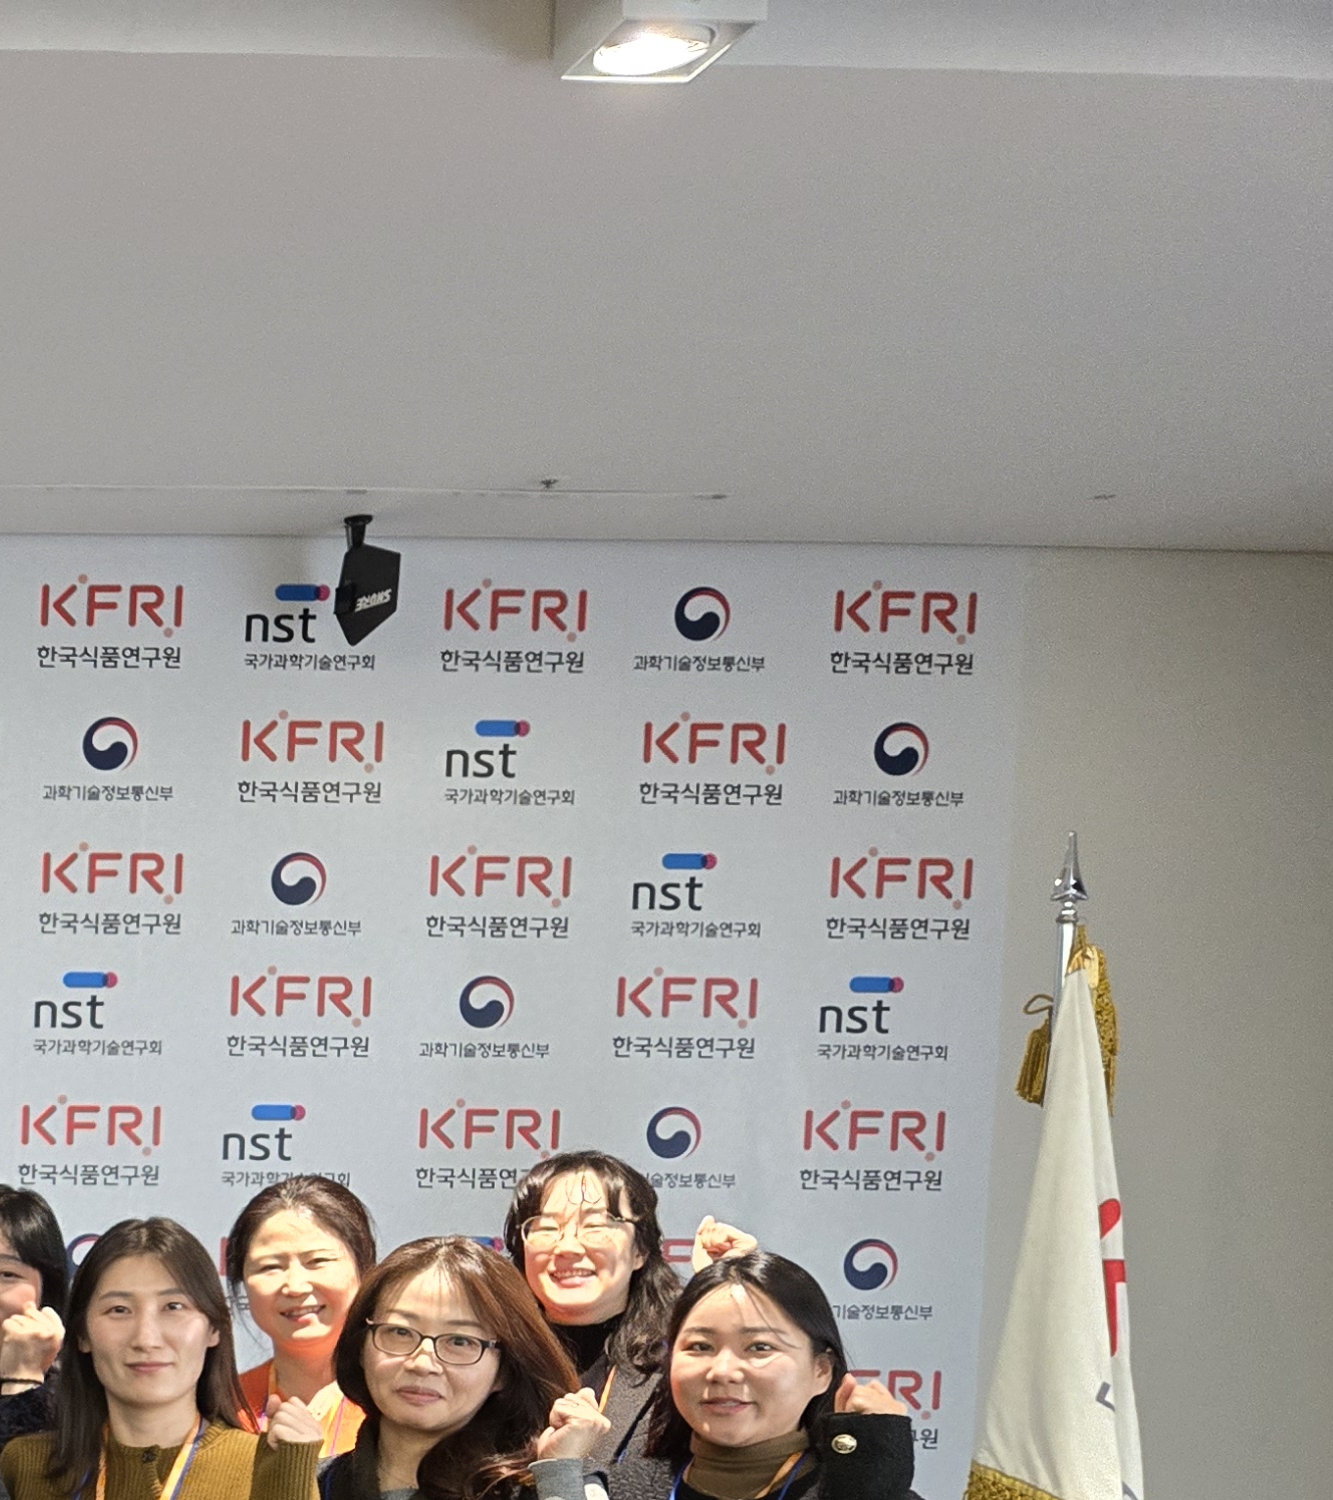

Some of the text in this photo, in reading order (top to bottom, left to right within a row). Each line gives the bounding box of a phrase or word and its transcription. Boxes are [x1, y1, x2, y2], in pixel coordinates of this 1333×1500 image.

[41, 585, 183, 626] KFRI
[444, 590, 587, 631] KFRI
[835, 591, 977, 633] KFRI
[245, 608, 316, 643] nst
[38, 646, 180, 669] 한국식품연구원
[245, 654, 375, 670] 국가과학기술연구회
[441, 650, 584, 673] 한국식품연구원
[634, 656, 765, 672] 과학기술정보통신부
[831, 652, 973, 675] 한국식품연구원
[243, 721, 383, 761] KFRI
[645, 723, 785, 763] KFRI
[446, 744, 516, 778] nst
[43, 785, 172, 802] 과학기술정보통신부
[238, 781, 381, 803] 한국식품연구원
[445, 789, 575, 806] 국가과학기술연구회
[640, 783, 782, 806] 한국식품연구원
[834, 790, 963, 807] 과학기술정보통신부
[42, 853, 183, 892] KFRI
[430, 856, 570, 896] KFRI
[832, 857, 972, 897] KFRI
[632, 877, 703, 911] nst
[39, 913, 181, 935] 한국식품연구원
[232, 920, 361, 936] 과학기술정보통신부
[427, 916, 568, 939] 한국식품연구원
[632, 921, 761, 938] 국가과학기술연구회
[827, 918, 970, 940] 한국식품연구원
[231, 976, 371, 1015] KFRI
[618, 977, 757, 1016] KFRI
[34, 995, 104, 1029] nst
[820, 1000, 890, 1034] nst
[34, 1039, 162, 1056] 국가과학기술연구회
[227, 1036, 369, 1058] 한국식품연구원
[420, 1043, 549, 1059] 과학기술정보통신부
[613, 1036, 755, 1059] 한국식품연구원
[818, 1044, 948, 1061] 국가과학기술연구회
[21, 1105, 161, 1145] KFRI
[420, 1108, 559, 1149] KFRI
[804, 1110, 945, 1151] KFRI
[223, 1128, 292, 1161] nst
[17, 1163, 160, 1187] 한국식품연구원
[801, 1170, 942, 1191] 한국식품연구원
